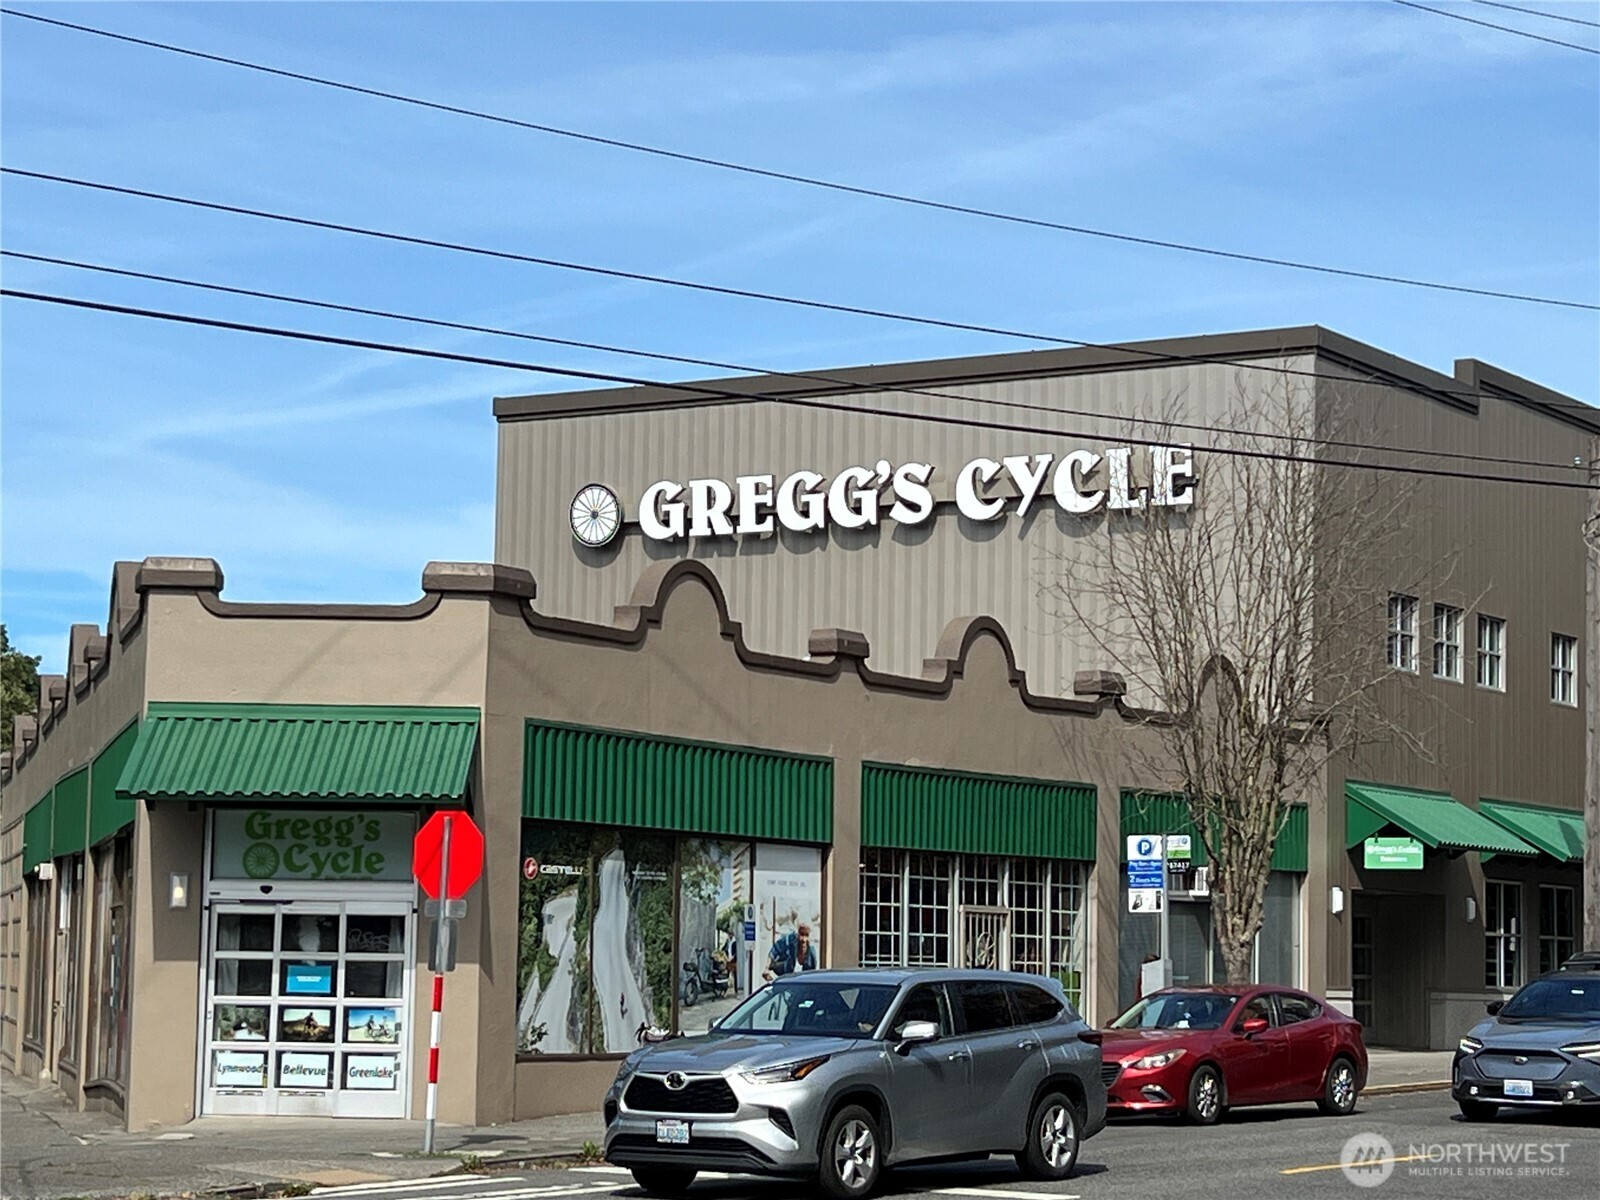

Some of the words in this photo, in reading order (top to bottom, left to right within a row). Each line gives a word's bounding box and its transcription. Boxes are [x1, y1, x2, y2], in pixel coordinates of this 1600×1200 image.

[638, 459, 933, 540] GREGG'S
[955, 442, 1195, 521] CYCLE
[244, 811, 381, 848] Gregg's
[283, 843, 385, 879] Cycle
[283, 1064, 326, 1076] Bellevue
[349, 1066, 393, 1078] Greenlake
